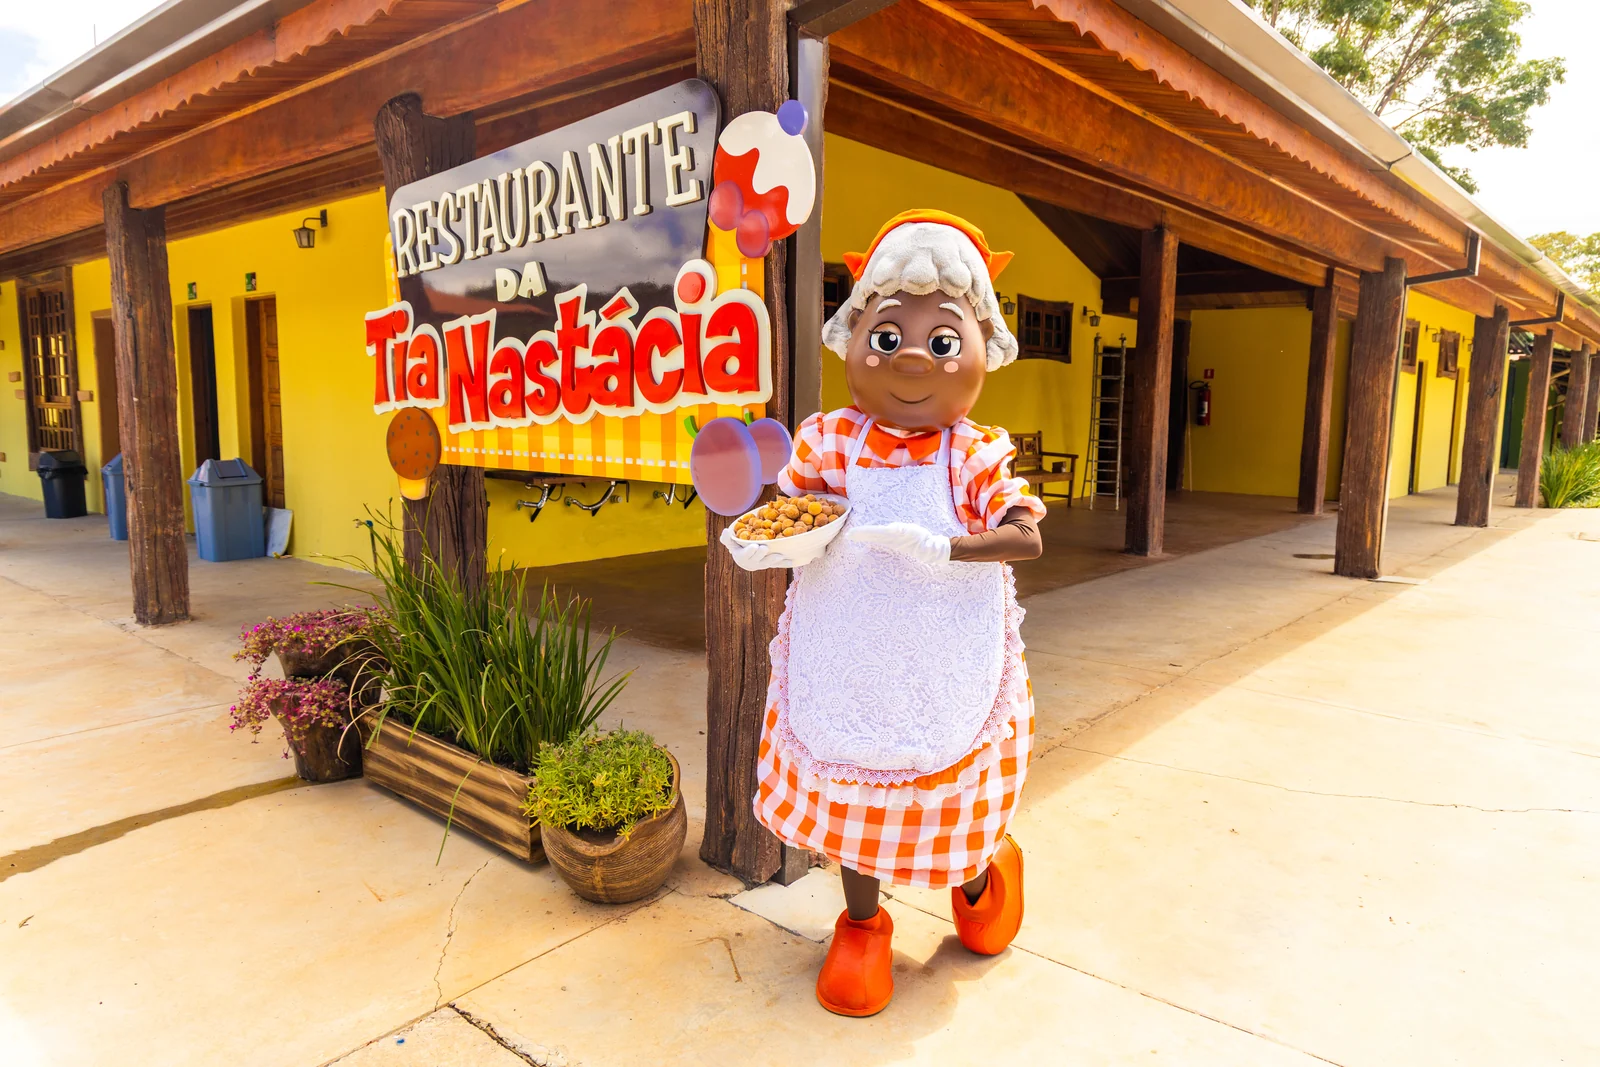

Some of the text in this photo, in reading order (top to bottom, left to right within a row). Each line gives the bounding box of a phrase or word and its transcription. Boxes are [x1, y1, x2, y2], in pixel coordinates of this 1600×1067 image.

[393, 111, 703, 277] RESTAURANTE
[366, 271, 760, 426] Tia Nastácia
[495, 261, 547, 302] DA
